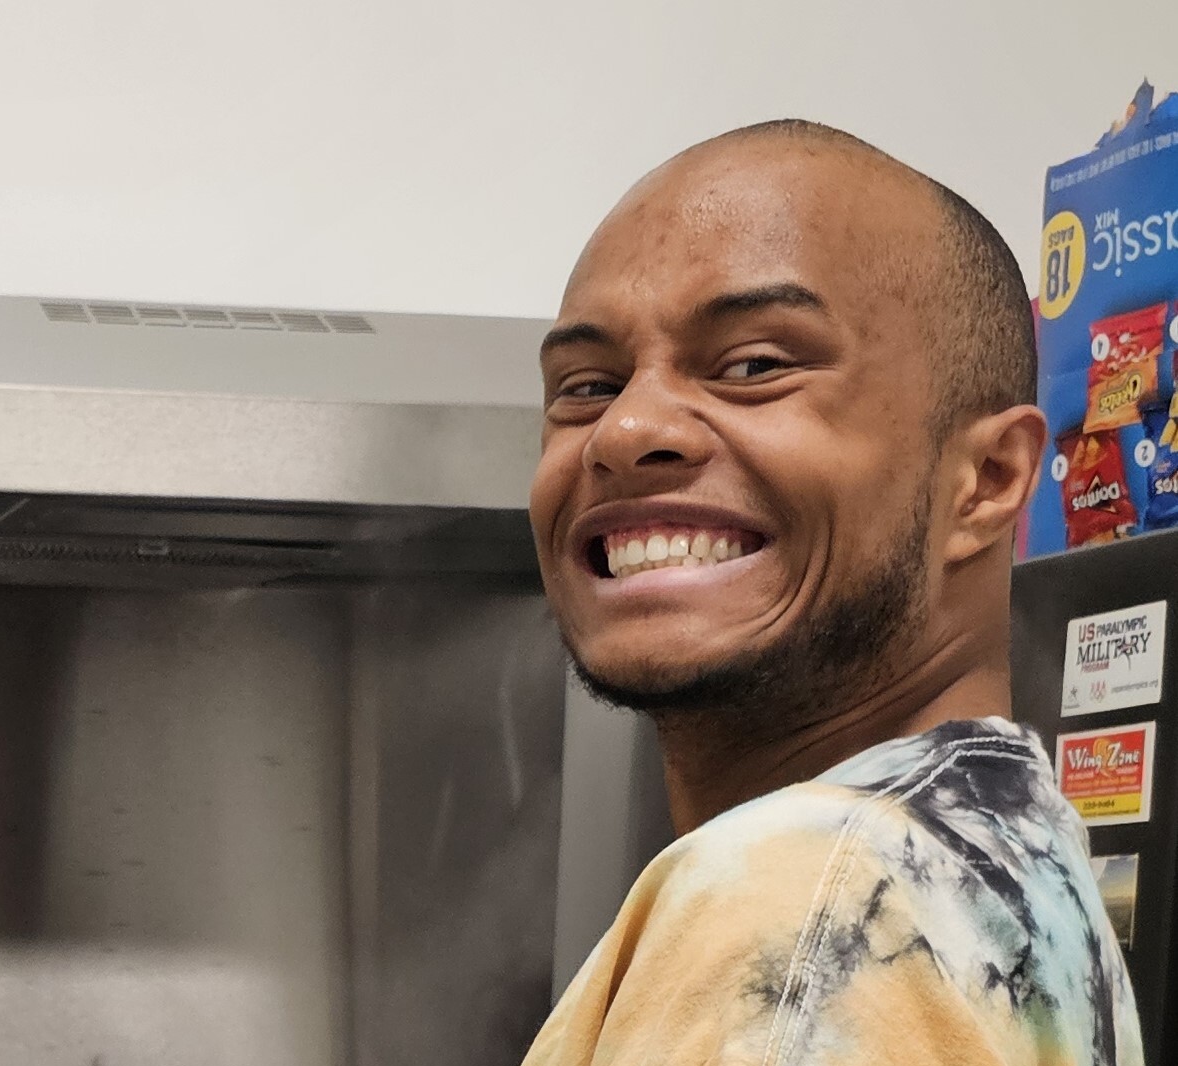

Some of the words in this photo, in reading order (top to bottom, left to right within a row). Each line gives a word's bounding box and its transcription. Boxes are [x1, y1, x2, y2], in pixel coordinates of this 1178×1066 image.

[1094, 207, 1120, 233] MIX
[1048, 225, 1075, 249] BAGS
[1046, 245, 1071, 303] 18
[1099, 374, 1142, 413] Cheetos
[1141, 445, 1148, 462] 2
[1078, 623, 1096, 643] US
[1096, 615, 1148, 639] PARALYMPIC
[1076, 632, 1152, 665] MILITARY
[1067, 747, 1102, 774] Wing
